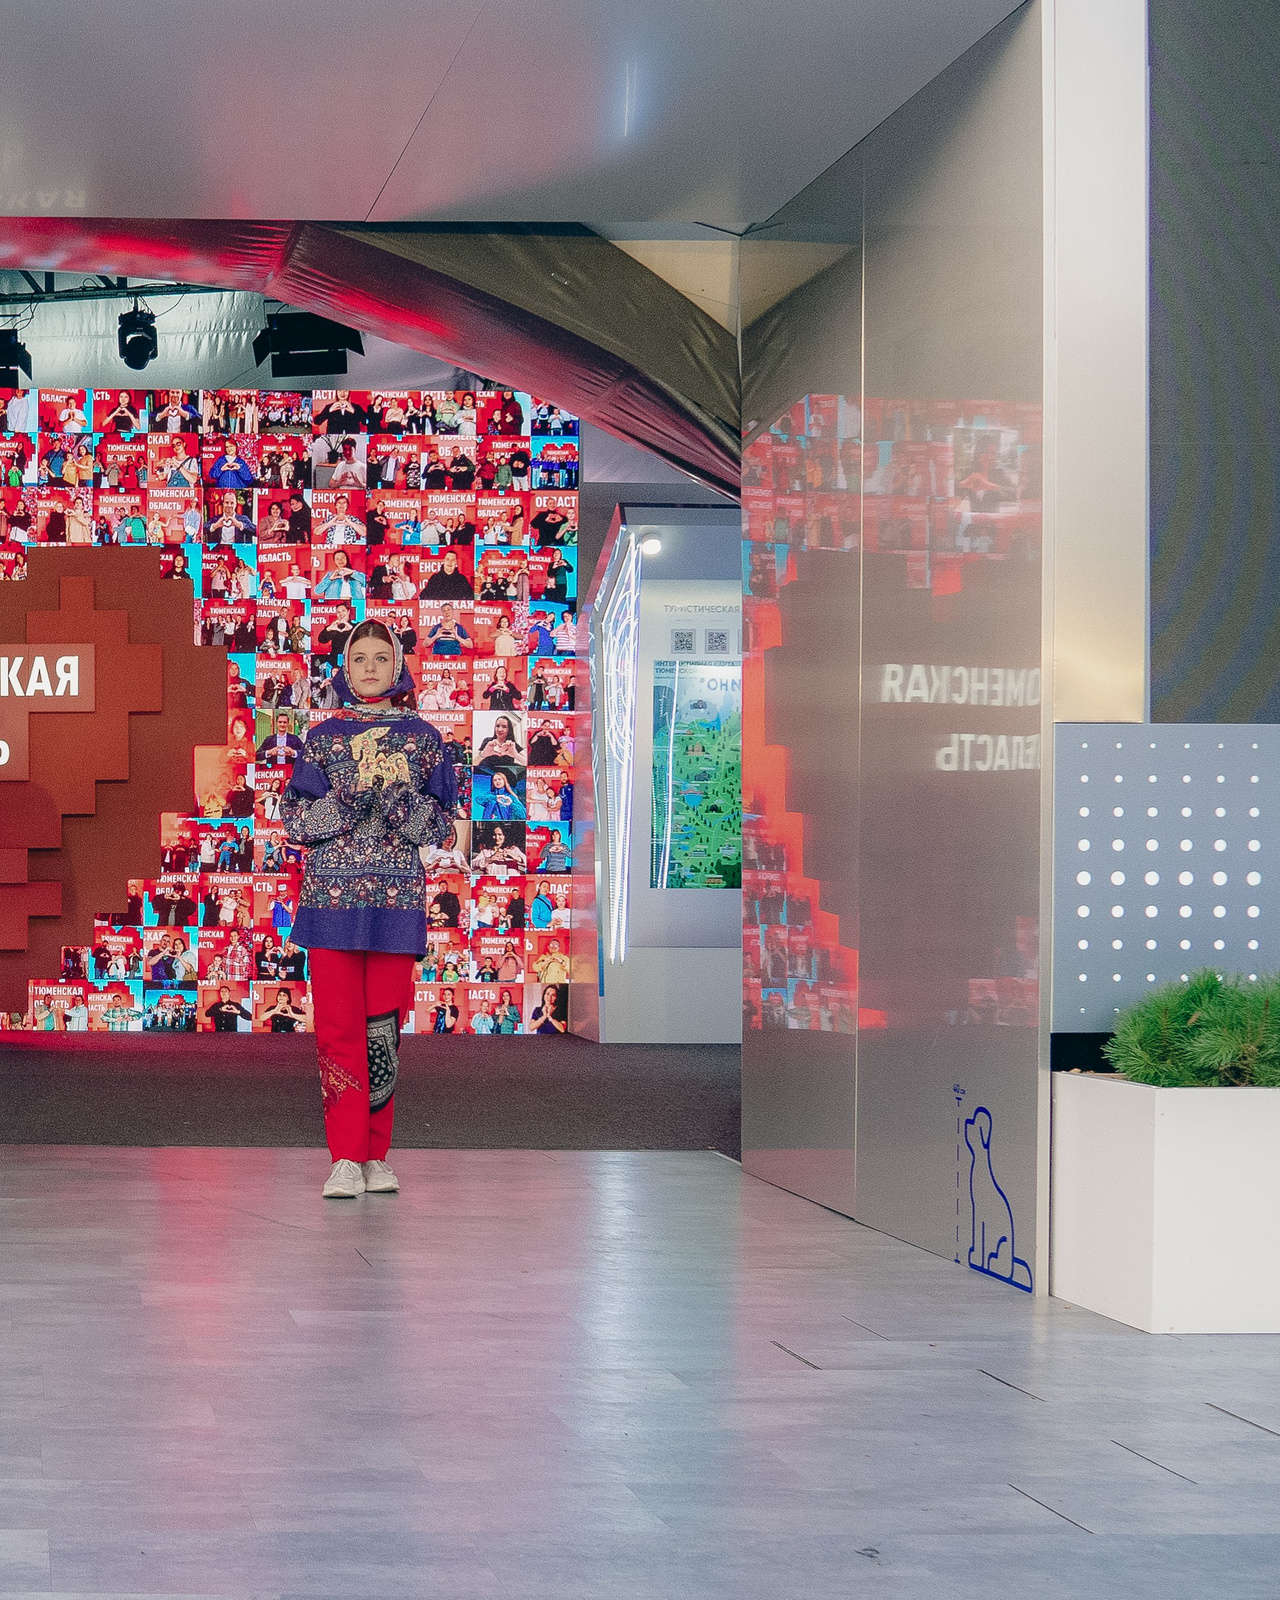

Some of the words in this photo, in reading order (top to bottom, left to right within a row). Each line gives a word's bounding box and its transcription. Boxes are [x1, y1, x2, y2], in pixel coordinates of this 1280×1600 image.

[107, 444, 145, 452] ТЮМЕНСКАЯ
[149, 489, 194, 498] ТЮМЕНСКАЯ
[428, 494, 476, 503] ТЮМЕНСКАЯ
[478, 498, 519, 506] ТЮМЕНСКАЯ
[149, 501, 182, 511] ОБЛАСТЬ
[258, 553, 292, 562] ОБЛАСТЬ
[422, 662, 467, 670] ТЮМЕНСКАЯ
[34, 986, 83, 996] ТЮМЕНСКАЯ
